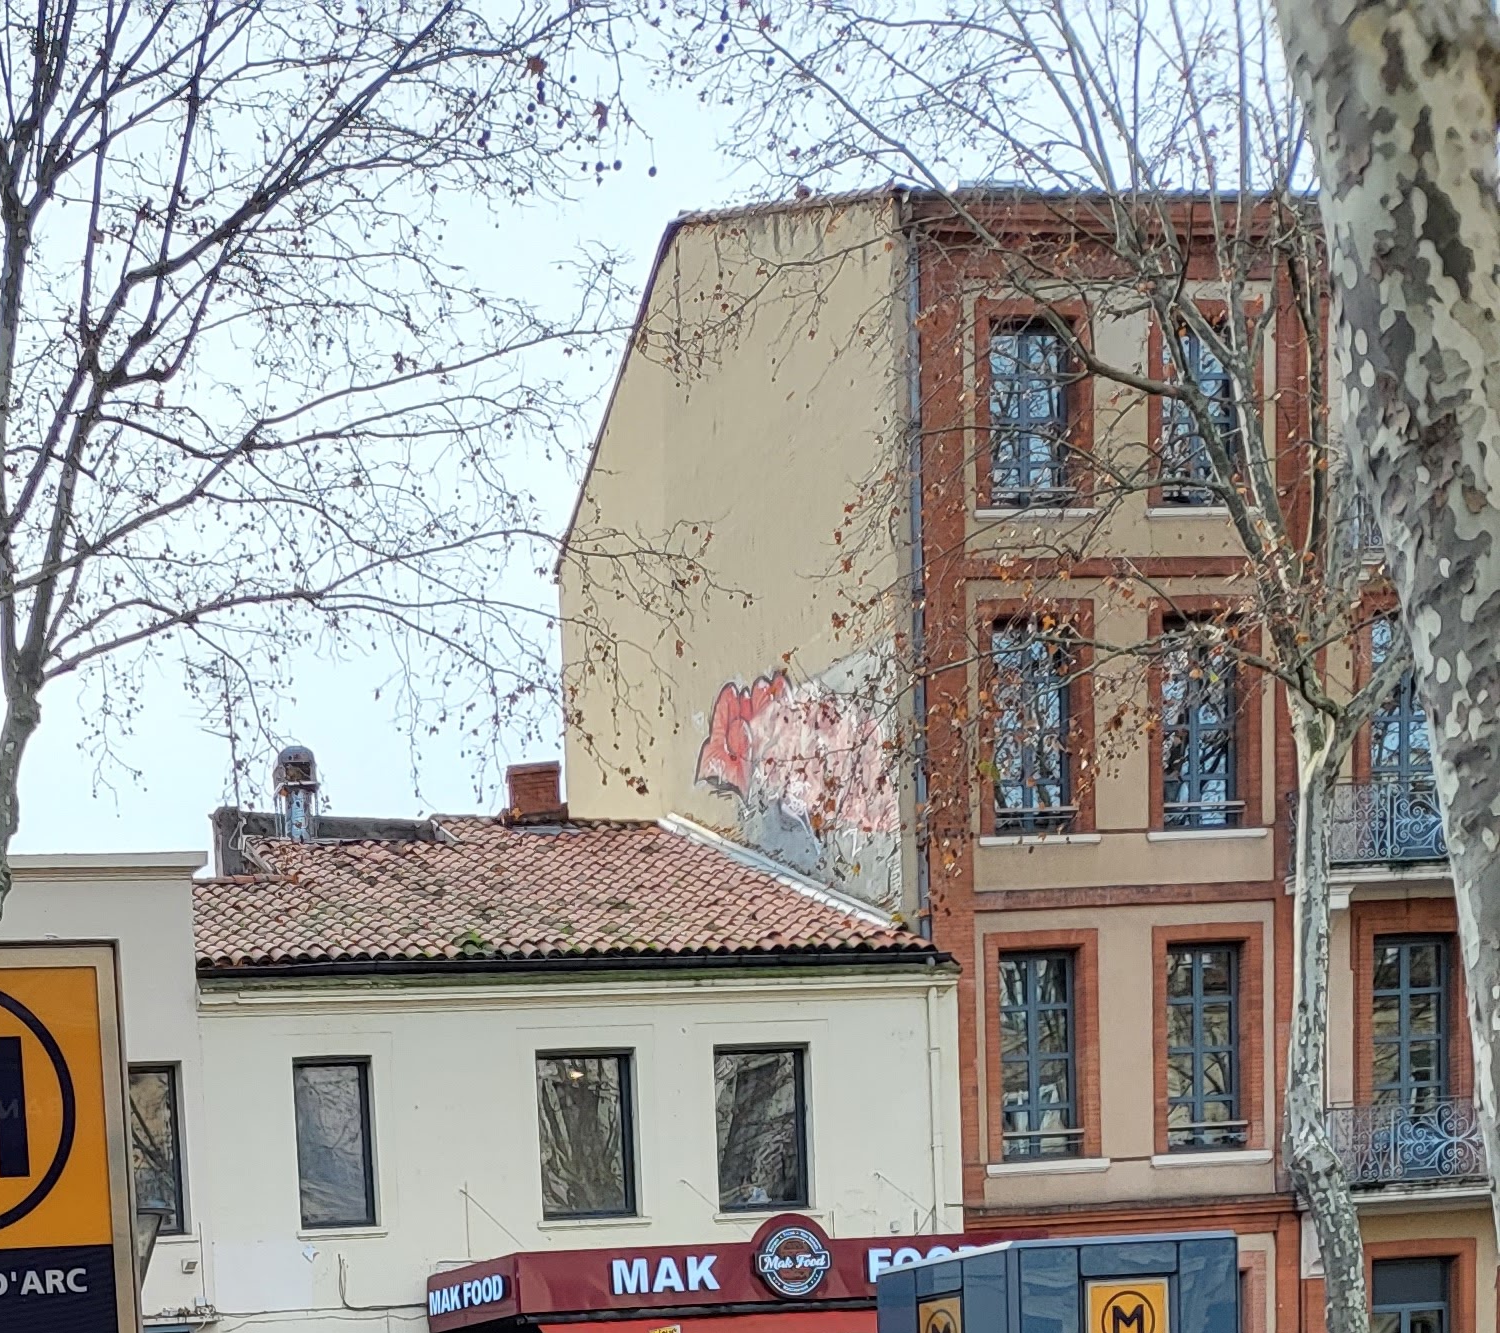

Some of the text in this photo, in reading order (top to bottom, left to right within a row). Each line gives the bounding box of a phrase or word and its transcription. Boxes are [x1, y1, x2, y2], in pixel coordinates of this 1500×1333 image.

[612, 1254, 721, 1295] MAK
[763, 1253, 827, 1271] Mak Food
[429, 1274, 504, 1317] MAK FOOD
